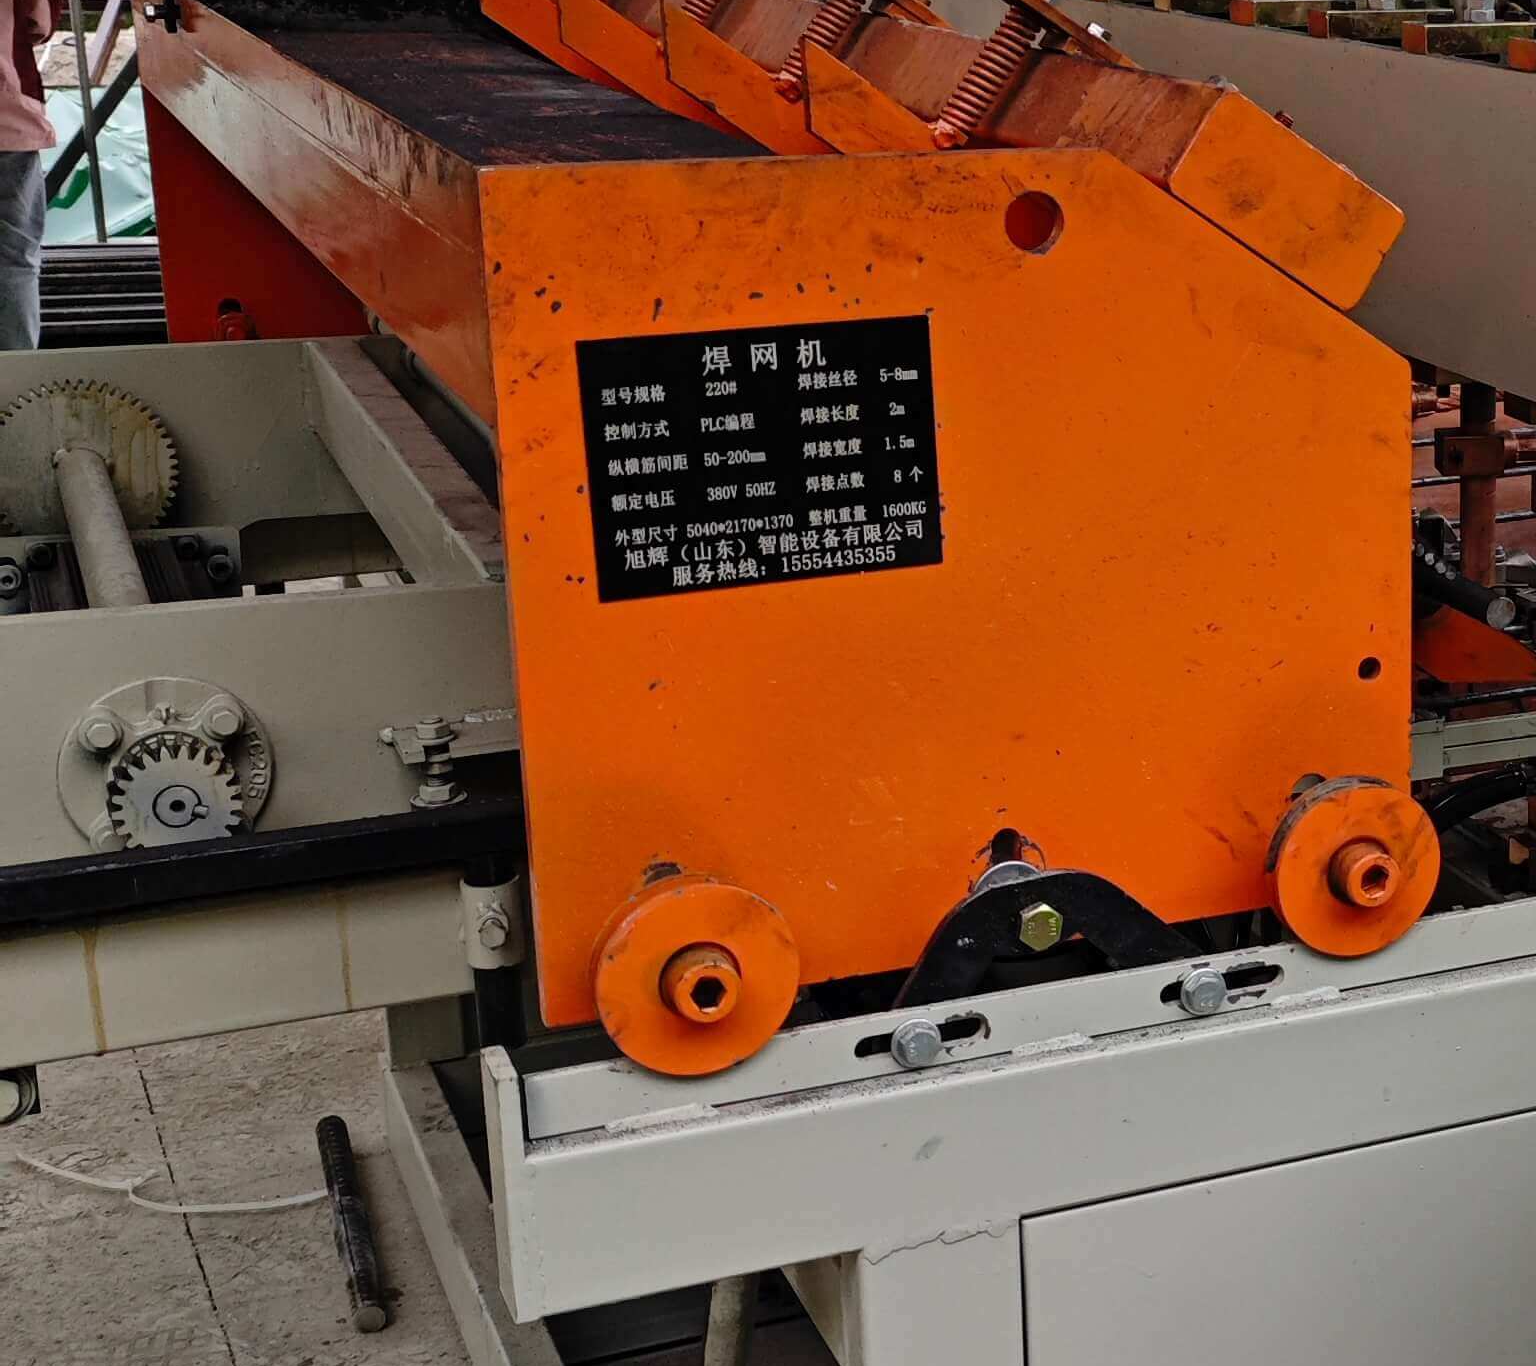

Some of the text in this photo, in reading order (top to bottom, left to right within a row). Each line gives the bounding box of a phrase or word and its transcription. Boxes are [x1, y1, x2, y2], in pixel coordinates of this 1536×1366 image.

[702, 339, 827, 376] 焊网机
[798, 370, 858, 391] 焊接丝径
[879, 367, 918, 382] 5-8mm
[601, 385, 666, 407] 型号规格
[800, 404, 860, 426] 焊接长度
[889, 402, 905, 416] 2m
[604, 419, 670, 442] 控制方式
[700, 412, 756, 433] PLC编程
[803, 438, 863, 460] 焊接宽度
[885, 436, 915, 451] 1.5m
[608, 453, 689, 477] 纵横筋间距
[703, 450, 766, 467] 50-200mm
[707, 482, 776, 501] 380V 50HZ
[805, 471, 865, 493] 焊接点数
[611, 490, 676, 512] 额定电压
[882, 500, 927, 518] 1600KG
[808, 504, 867, 527] 整机重量
[615, 524, 678, 547] 外型尺寸
